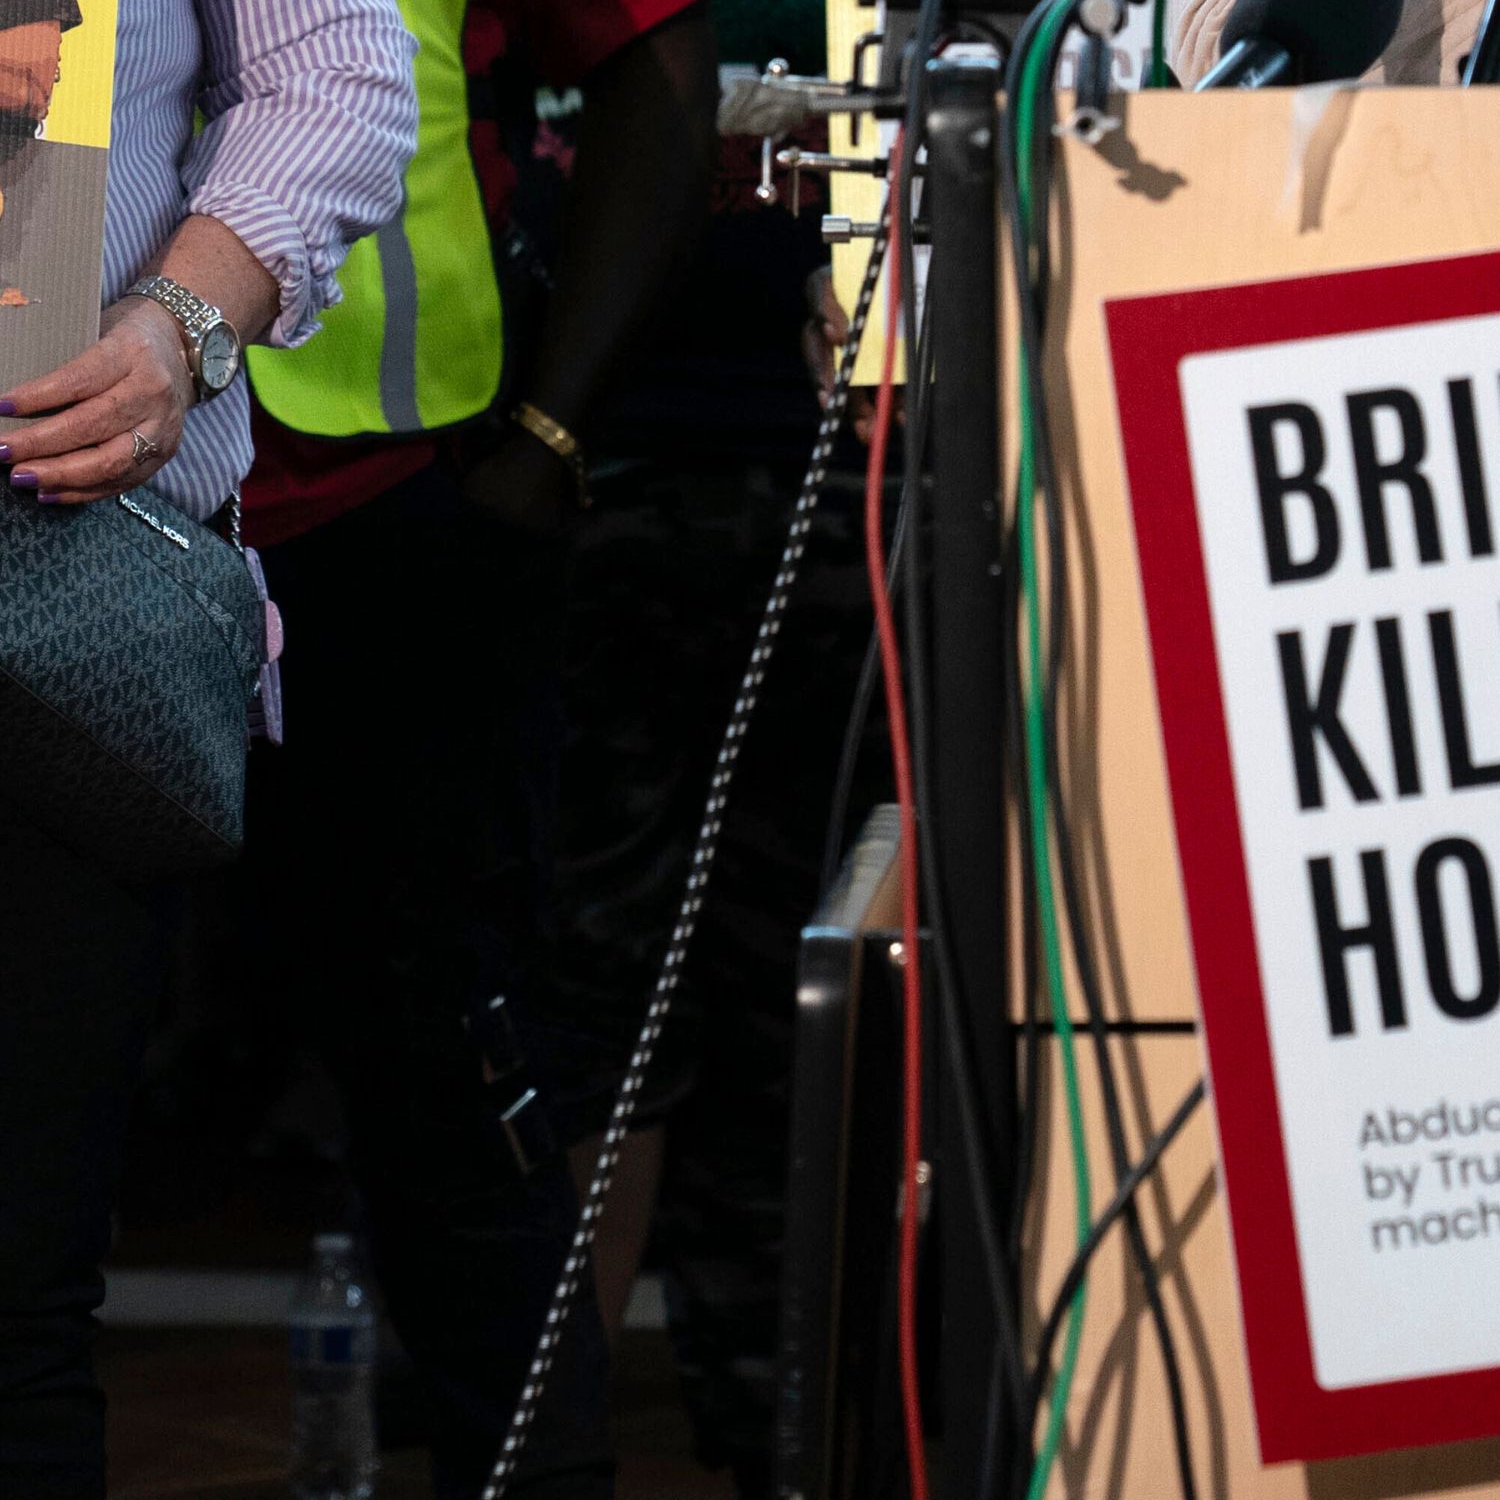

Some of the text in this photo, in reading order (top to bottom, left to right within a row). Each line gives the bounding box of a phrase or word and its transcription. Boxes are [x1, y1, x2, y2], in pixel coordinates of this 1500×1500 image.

[120, 494, 190, 550] MICHAEL KORS
[1364, 1162, 1420, 1204] by
